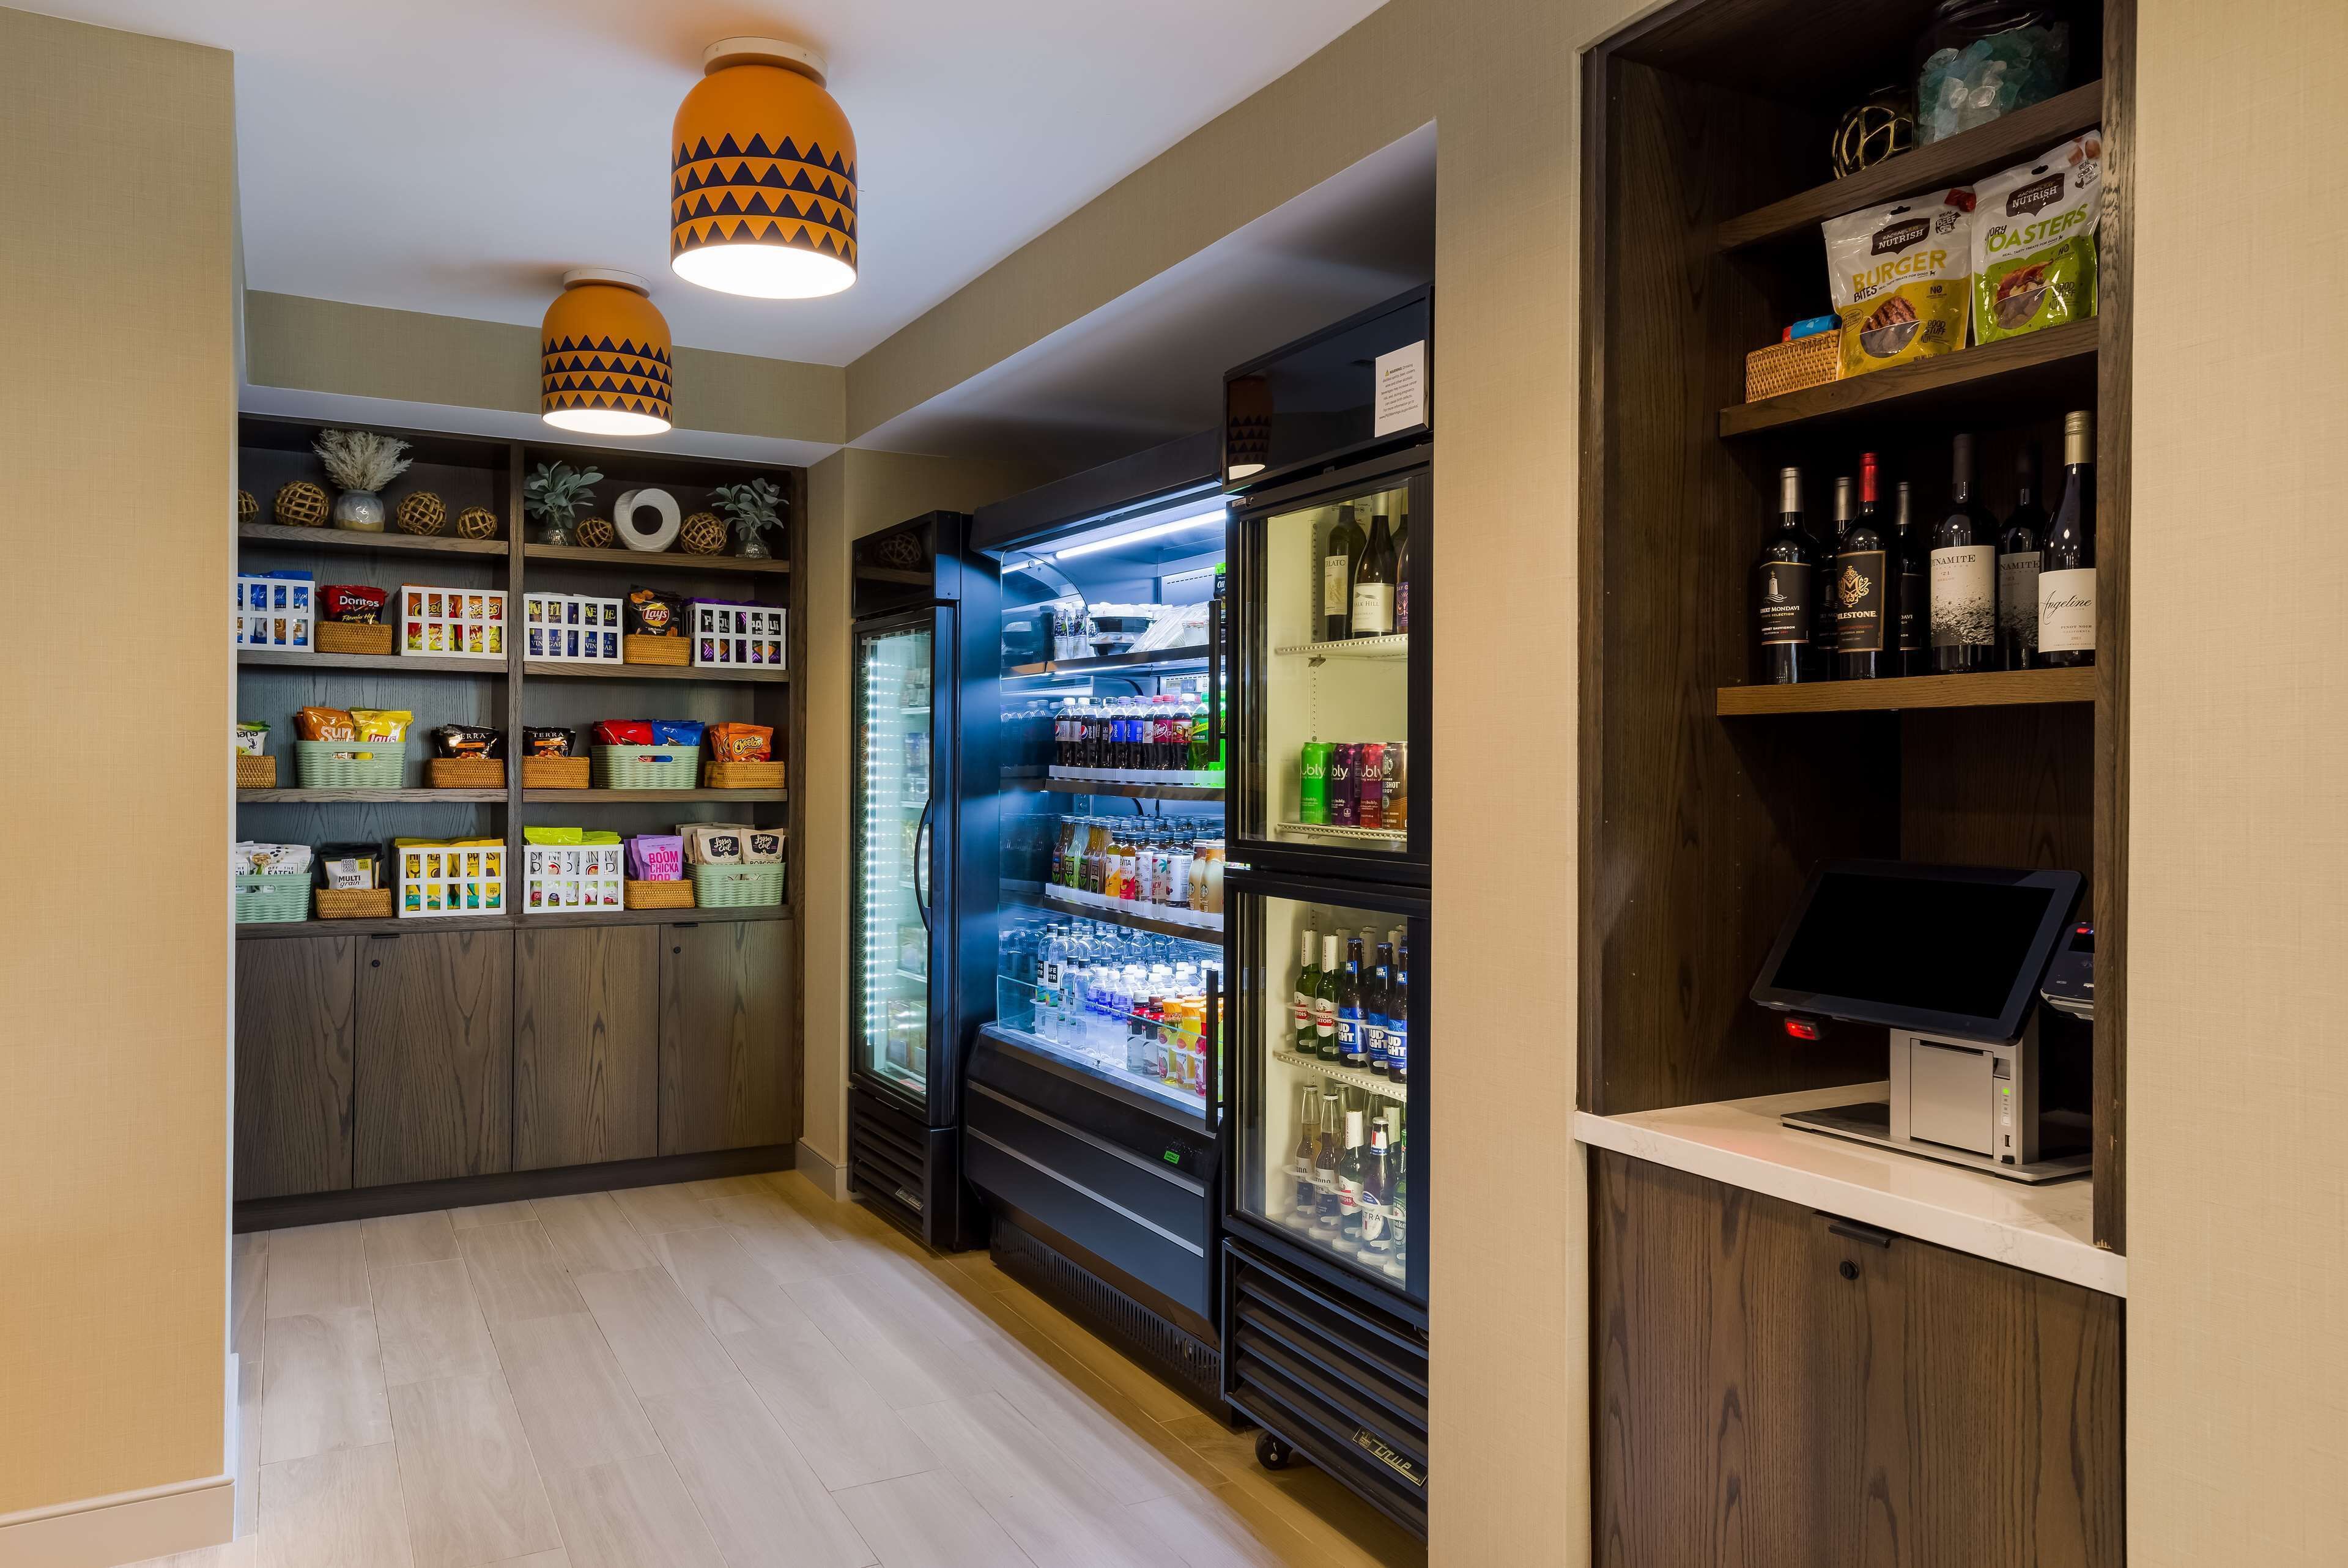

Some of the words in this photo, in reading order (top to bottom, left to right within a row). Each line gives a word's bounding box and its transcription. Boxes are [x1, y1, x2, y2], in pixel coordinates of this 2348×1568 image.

[2013, 185, 2057, 209] NUTRISH
[1937, 216, 1956, 227] BEEF
[1988, 204, 2088, 253] OASTERS
[1878, 229, 1924, 250] NUTRISH
[1853, 250, 1947, 292] BURGER
[1854, 285, 1877, 303] BITES
[1927, 319, 1946, 328] GOOD
[1926, 327, 1946, 335] STUFF
[1325, 559, 1346, 568] RLATO
[2001, 560, 2041, 571] NAMITE
[339, 596, 379, 607] Doritos
[2040, 590, 2092, 625] Angeline
[645, 610, 668, 621] Lay's
[320, 726, 355, 742] Sun
[733, 736, 762, 753] Cheetos
[1302, 763, 1326, 779] ubly
[1333, 764, 1349, 780] bly
[1361, 764, 1383, 782] ubly
[714, 837, 732, 848] Lesser
[755, 834, 773, 844] Lesser
[719, 843, 732, 852] Evil
[758, 841, 772, 849] Evil
[648, 851, 679, 864] BOOM
[650, 863, 679, 873] CHICKA
[1339, 1023, 1349, 1033] UD
[1338, 1032, 1354, 1042] GHT
[1388, 1035, 1401, 1046] UD
[1370, 1039, 1388, 1049] GHT
[1388, 1045, 1406, 1056] GHT
[1365, 1211, 1380, 1221] TRA
